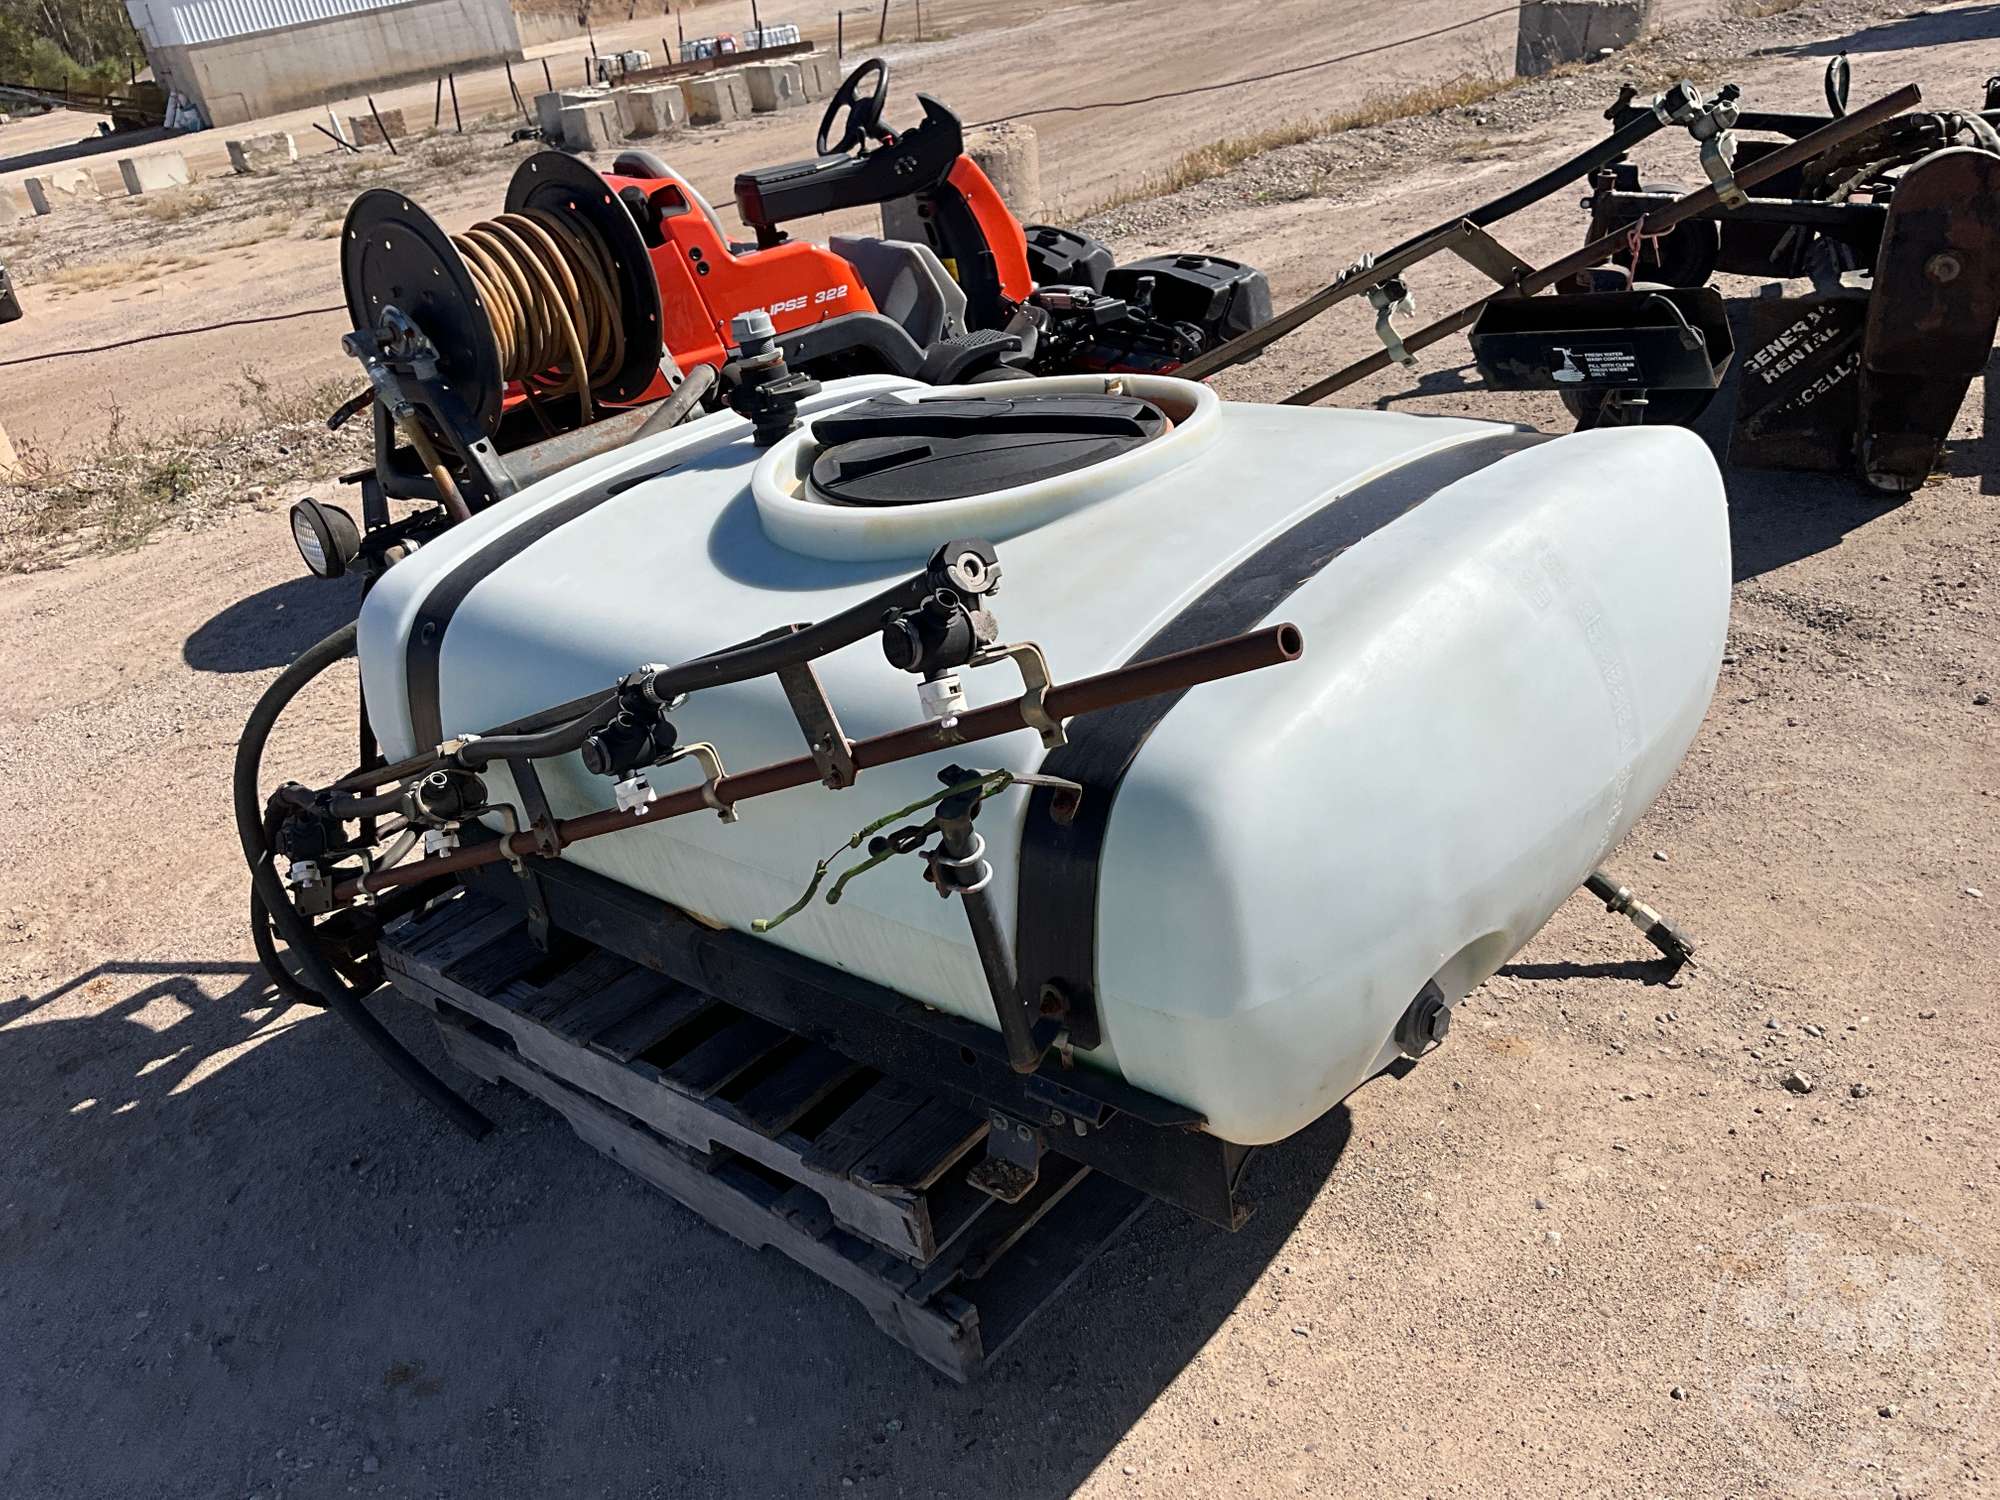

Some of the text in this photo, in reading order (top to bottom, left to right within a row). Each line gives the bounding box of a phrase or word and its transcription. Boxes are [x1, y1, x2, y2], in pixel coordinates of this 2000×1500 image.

[738, 284, 848, 317] IPSE 322
[1760, 327, 1841, 385] RENTAL
